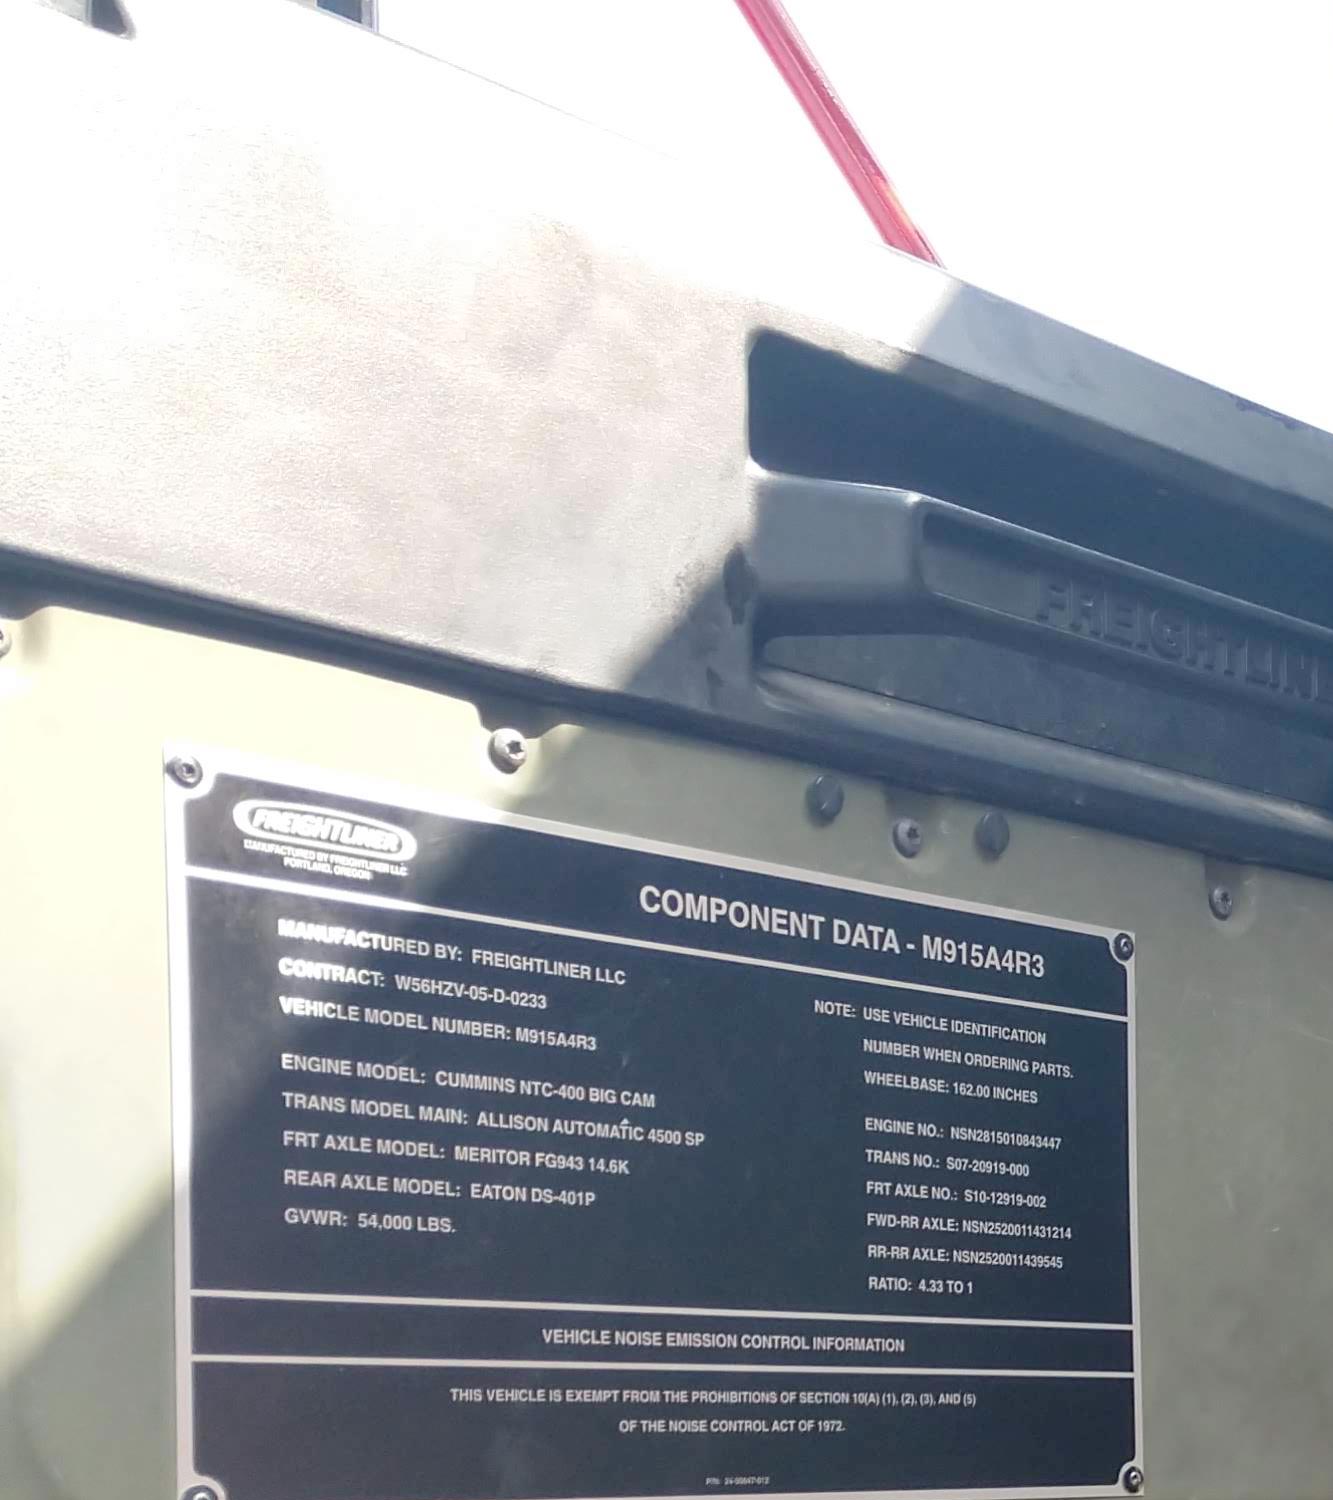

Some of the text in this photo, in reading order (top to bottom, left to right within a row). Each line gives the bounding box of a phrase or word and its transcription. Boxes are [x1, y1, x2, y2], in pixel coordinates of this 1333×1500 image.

[253, 808, 401, 853] FREIGHTLINER
[277, 917, 627, 986] MANUFACTURED BY: FREIGHTLINER LLC
[638, 884, 826, 941] COMPONENT
[832, 917, 901, 955] DATA
[921, 933, 1045, 979] M915A4R3
[277, 956, 547, 1010] CONTRACT: W56HZV-05-D-0233
[277, 994, 598, 1052] VEHICLE MODEL NUMBER: M915A4R3
[813, 998, 1047, 1046] NOTE: USE VEHICLE IDENTIFICATION
[280, 1051, 656, 1108] ENGINE MODEL: CUMMINS NTC-400 BIG CAM
[863, 1069, 1038, 1105] WHEELBASE: 162.00 INCHES
[864, 1116, 915, 1136] ENGINE
[916, 1121, 945, 1138] NO.:
[541, 1327, 906, 1353] VEHICLE NOISE EMISSION CONTROL INFORMATION
